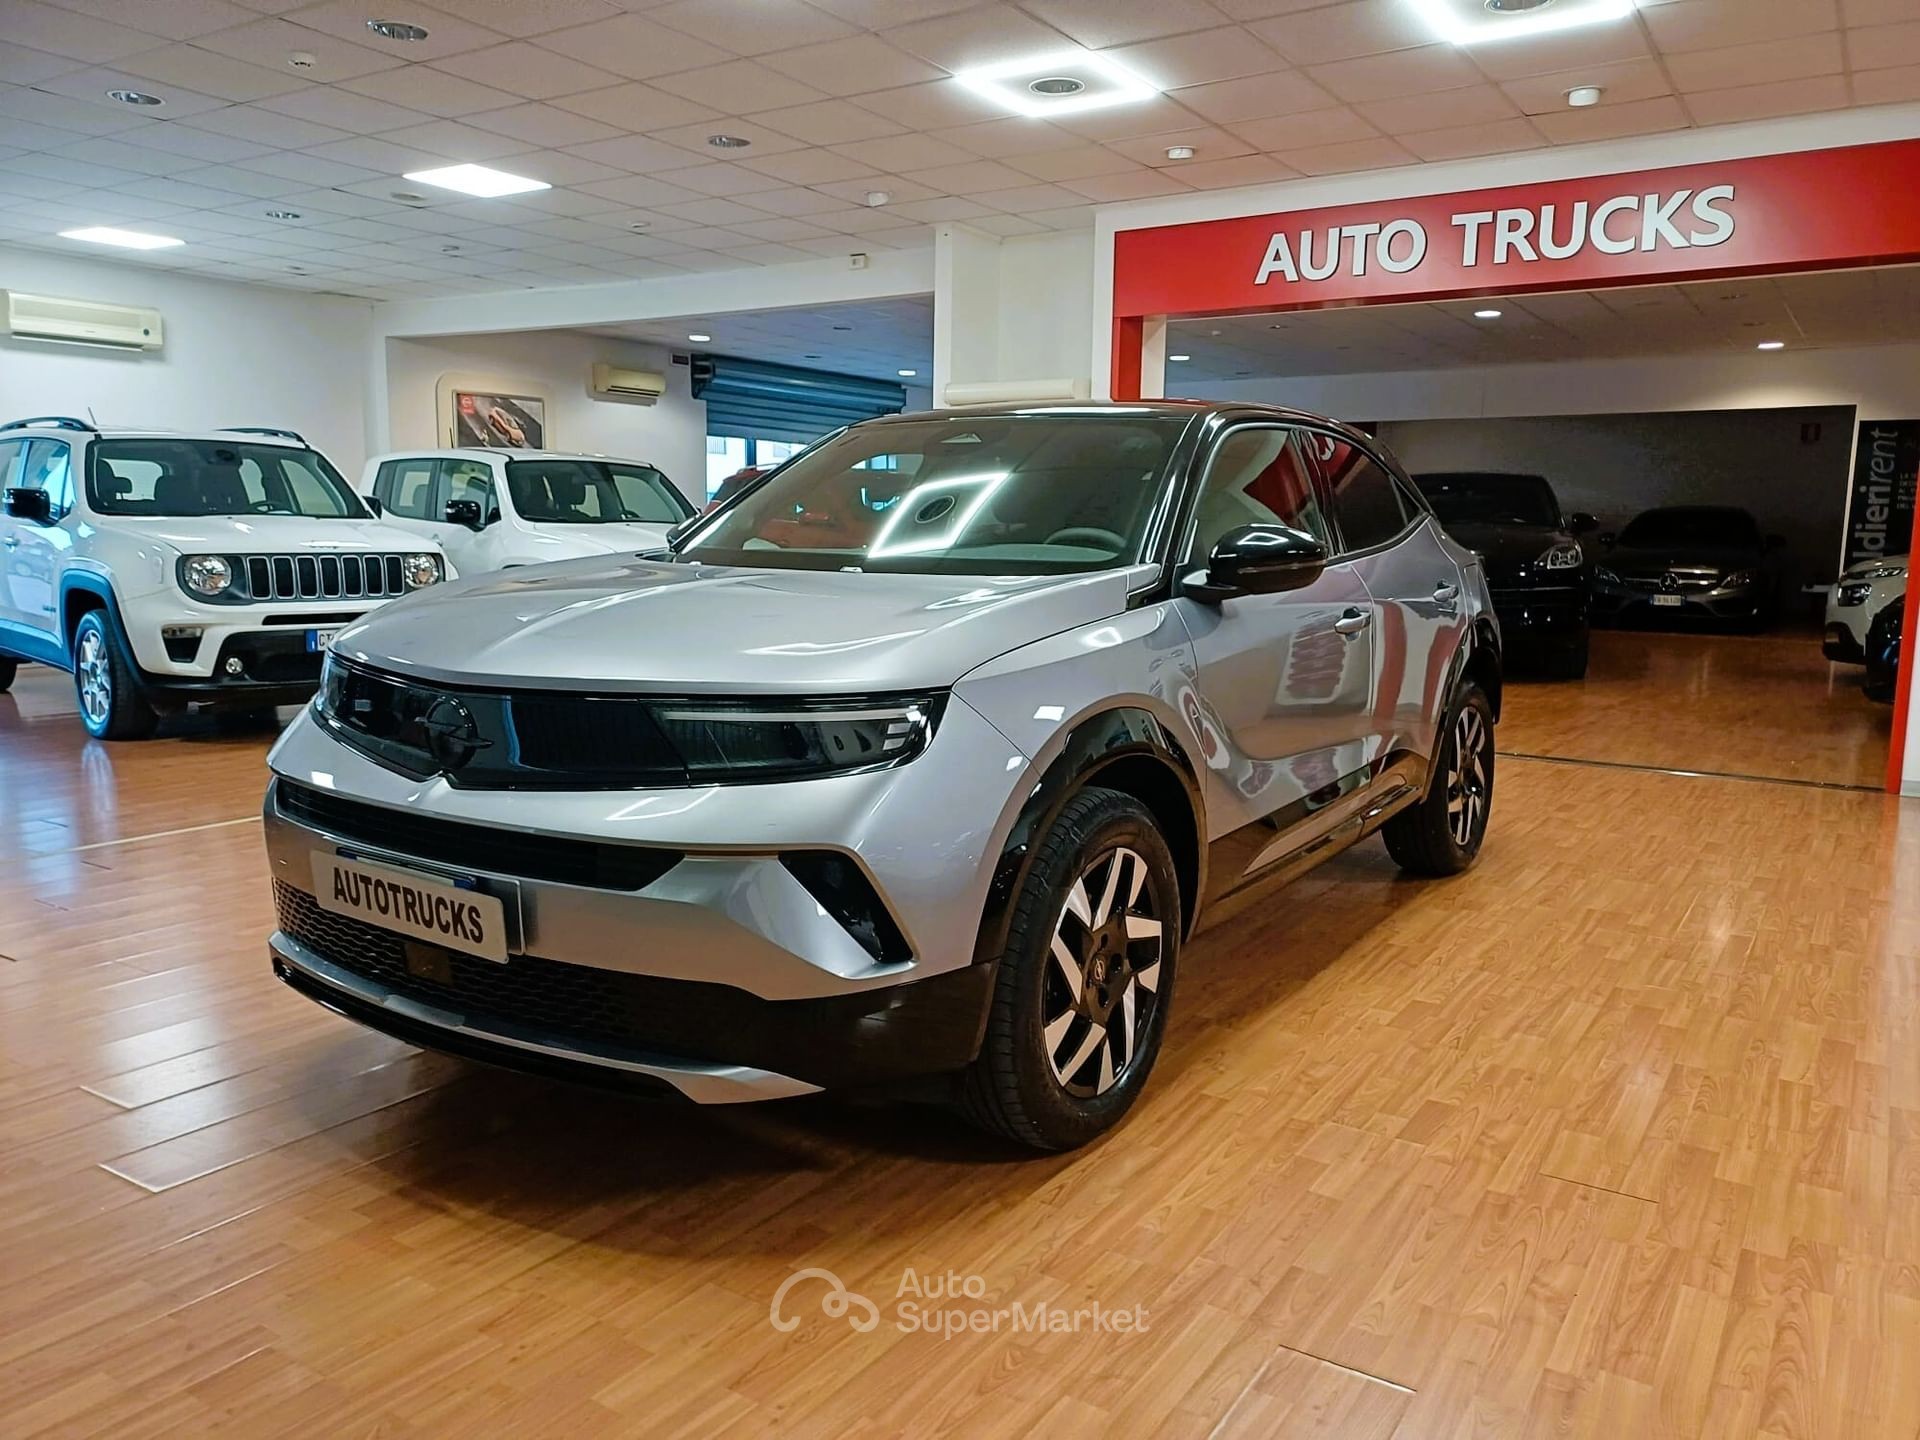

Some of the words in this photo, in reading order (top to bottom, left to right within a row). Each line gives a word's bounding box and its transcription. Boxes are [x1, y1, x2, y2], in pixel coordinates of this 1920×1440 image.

[1254, 218, 1427, 285] AUTO
[1451, 185, 1736, 267] TRUCKS
[333, 867, 484, 944] AUTOTRUCKS
